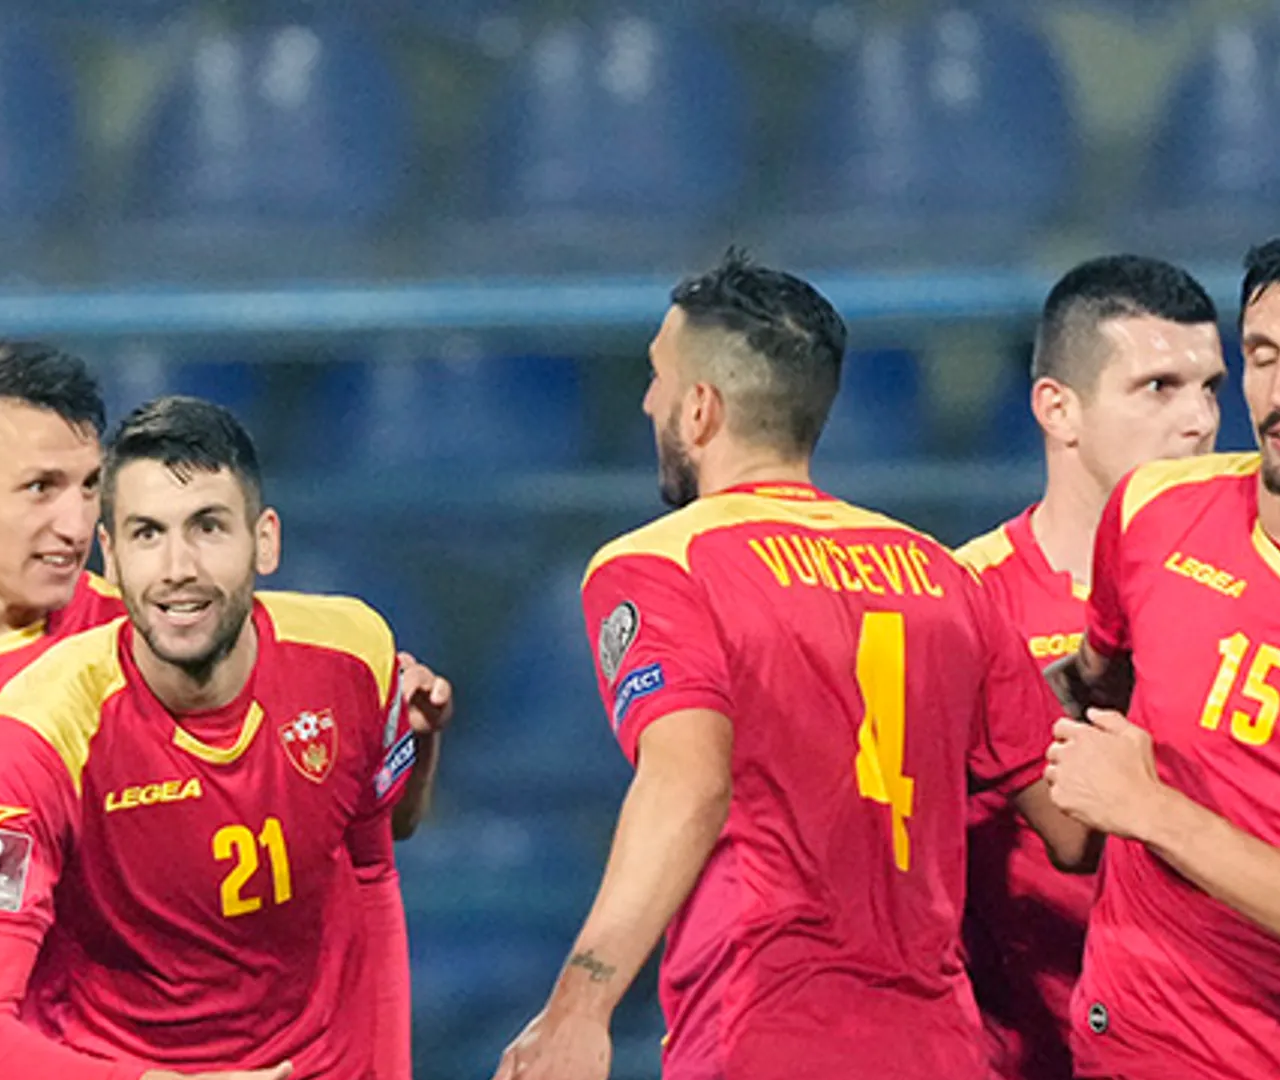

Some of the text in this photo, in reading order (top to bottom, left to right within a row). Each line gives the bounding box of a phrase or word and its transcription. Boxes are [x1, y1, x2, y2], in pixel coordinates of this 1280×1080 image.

[1164, 551, 1246, 598] LEGEA
[855, 611, 913, 871] 4
[105, 778, 202, 812] LEGEA
[213, 818, 291, 916] 21
